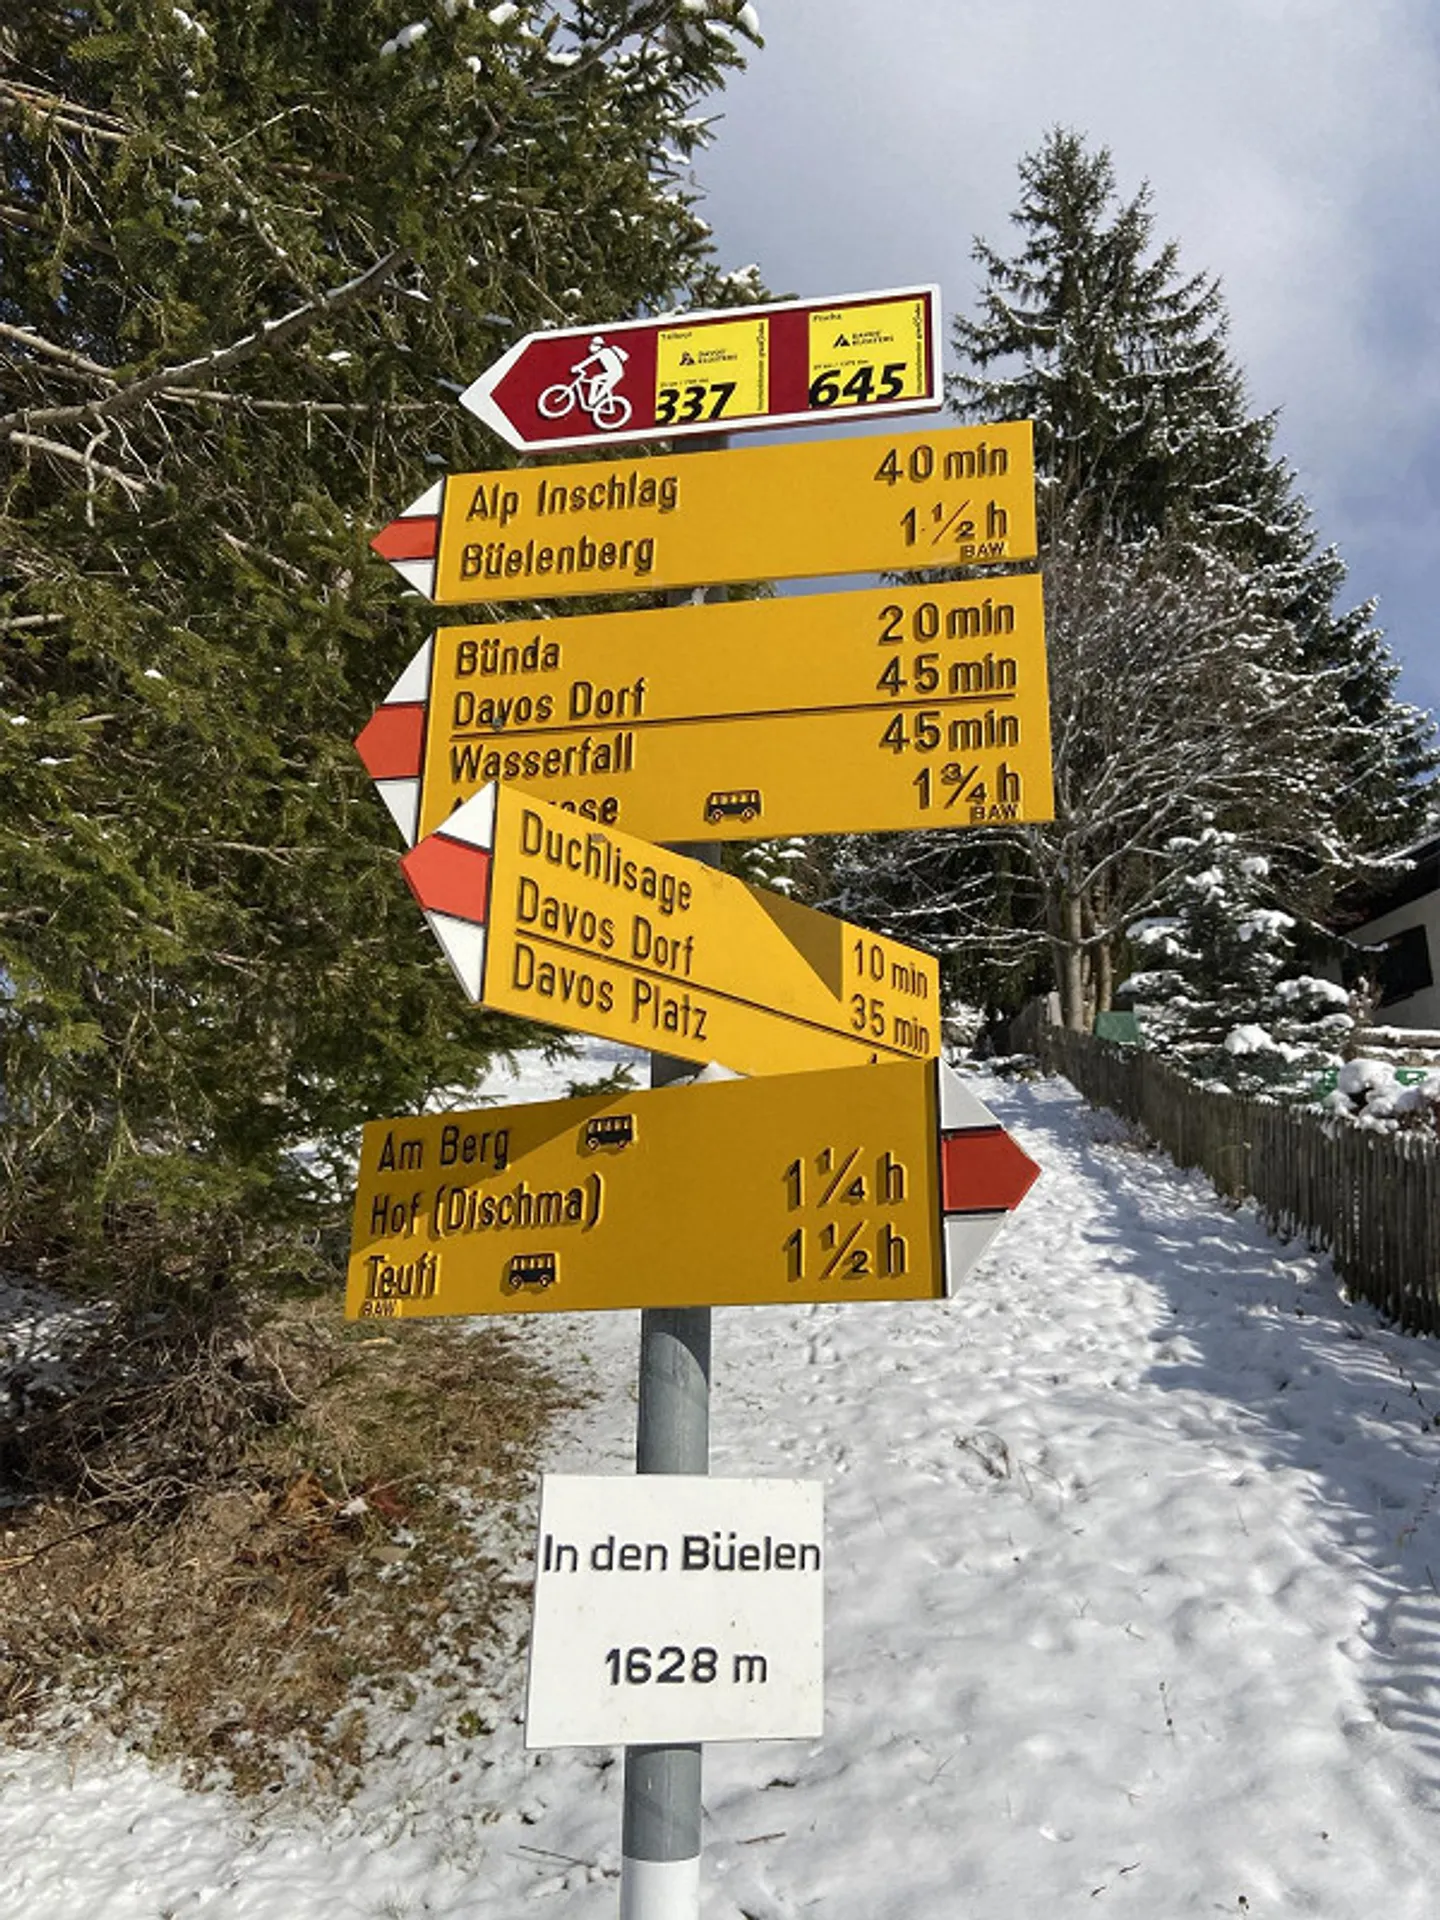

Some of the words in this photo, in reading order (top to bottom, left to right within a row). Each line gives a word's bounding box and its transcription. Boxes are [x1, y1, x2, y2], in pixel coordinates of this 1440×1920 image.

[656, 381, 737, 424] 337
[809, 362, 907, 407] 645
[874, 444, 934, 486] 40
[944, 442, 1008, 480] min
[466, 483, 519, 528] Alp
[537, 471, 679, 515] Inschlag
[986, 500, 1008, 540] h
[460, 536, 655, 581] Büelenberg
[962, 541, 1006, 560] BAW
[878, 602, 939, 646] 20
[947, 598, 1014, 639] min
[456, 635, 561, 679] Bünda
[877, 653, 941, 696] 45
[948, 652, 1017, 694] min
[453, 691, 553, 729] Davos
[570, 677, 647, 720] Dorf
[879, 711, 941, 754] 45
[948, 709, 1019, 751] min
[451, 732, 634, 784] Wasserfall
[996, 762, 1020, 804] h
[970, 804, 1018, 822] BAW
[520, 809, 692, 916] Duchlisage
[517, 876, 615, 949] Davos
[631, 915, 694, 976] Dorf
[513, 942, 614, 1013] Davos
[631, 977, 708, 1041] Platz
[853, 938, 885, 983] 10
[891, 962, 928, 999] min
[851, 993, 885, 1037] 35
[894, 1016, 930, 1055] min
[377, 1131, 424, 1172] Am
[440, 1124, 510, 1171] Berg
[878, 1151, 905, 1205] h
[370, 1190, 424, 1237] Hof
[431, 1172, 602, 1240] (Dischma)
[879, 1222, 906, 1278] h
[542, 1533, 578, 1572] In
[590, 1535, 668, 1571] den
[681, 1531, 821, 1571] Büelen
[604, 1646, 718, 1686] 1628
[732, 1653, 768, 1684] m
